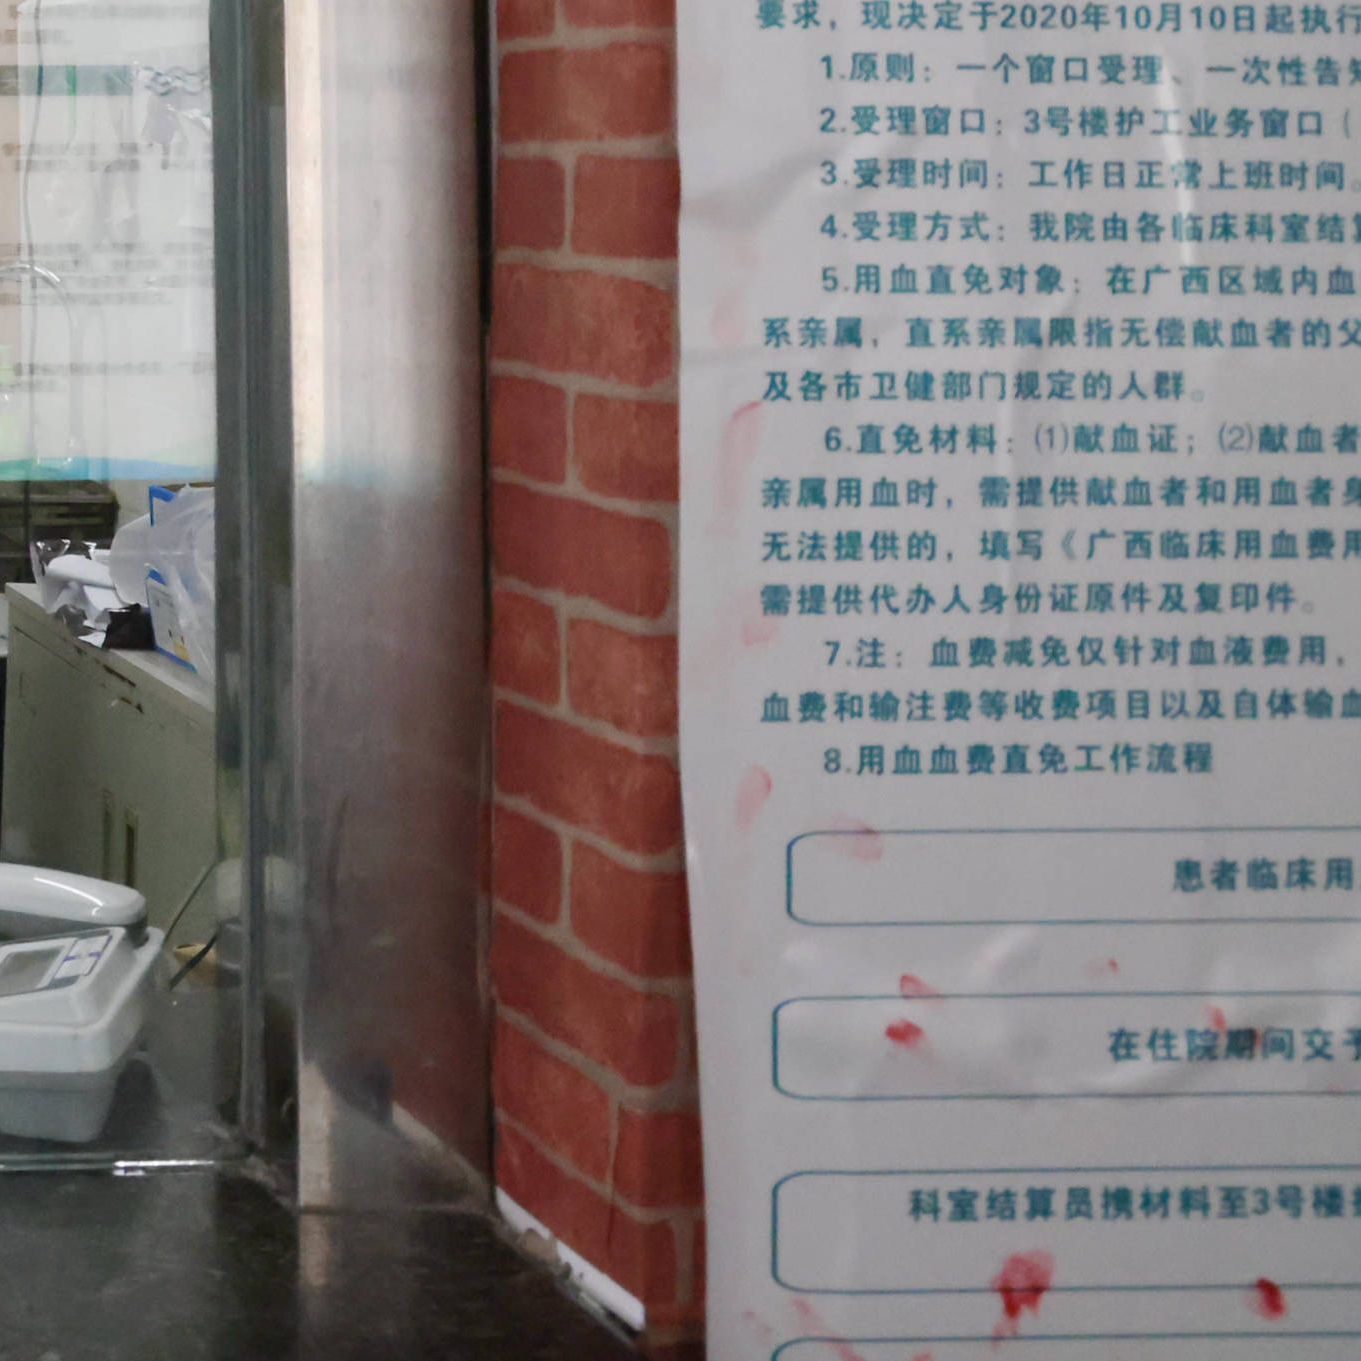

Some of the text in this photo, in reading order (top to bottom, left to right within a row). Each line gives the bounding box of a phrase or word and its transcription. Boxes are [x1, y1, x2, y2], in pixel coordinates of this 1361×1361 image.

[820, 210, 1361, 244] 4.受理方式：我院由各临床科室结
[824, 742, 1213, 776] 8.用血血费直免工作流程
